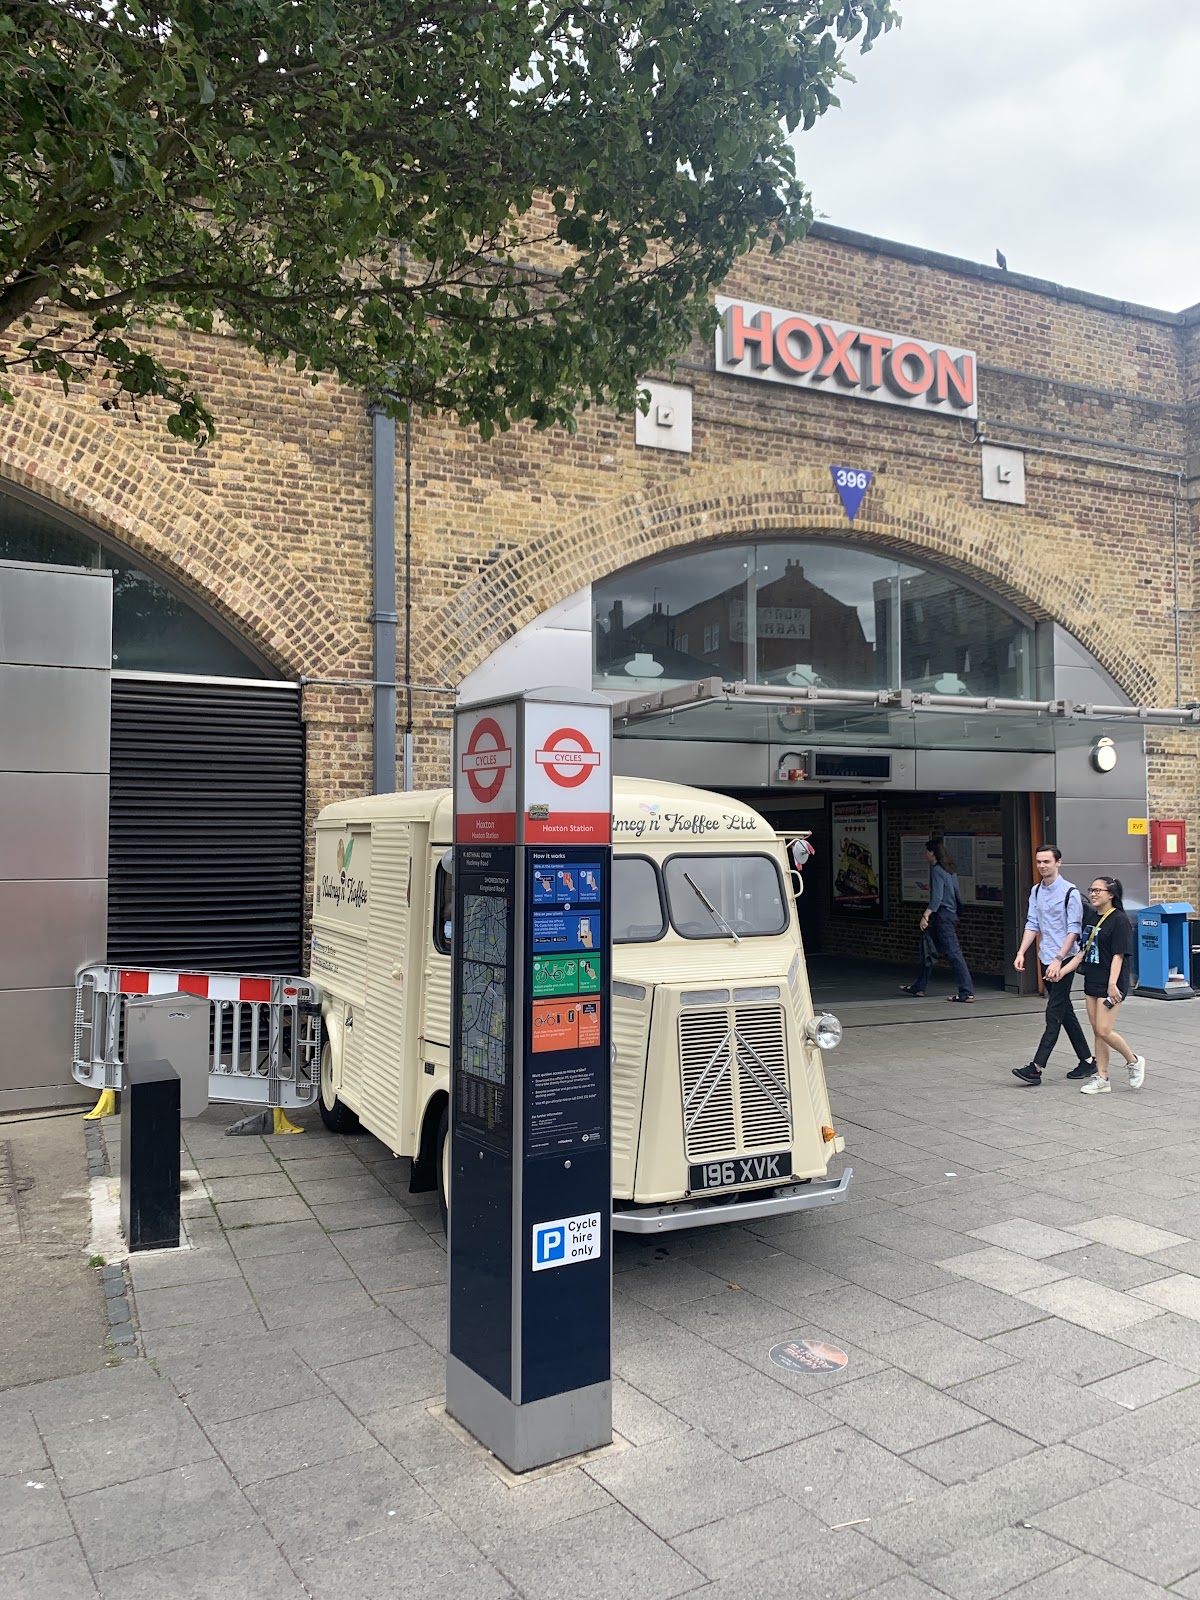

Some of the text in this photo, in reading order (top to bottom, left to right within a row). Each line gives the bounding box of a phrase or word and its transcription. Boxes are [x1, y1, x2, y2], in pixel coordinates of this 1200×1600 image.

[725, 305, 973, 408] HOXTON
[836, 470, 867, 489] 396
[475, 754, 497, 767] CYCLES
[554, 753, 582, 762] CYCLES
[475, 819, 495, 829] Hoxton
[542, 824, 594, 832] Hoxton Station
[664, 813, 720, 834] Koffee
[722, 814, 757, 830] Ltd
[347, 877, 368, 908] Koffee
[702, 1155, 780, 1187] 196 XVK
[568, 1218, 597, 1232] Cycle
[543, 1231, 562, 1260] P
[572, 1233, 593, 1244] hire
[571, 1244, 594, 1257] only
